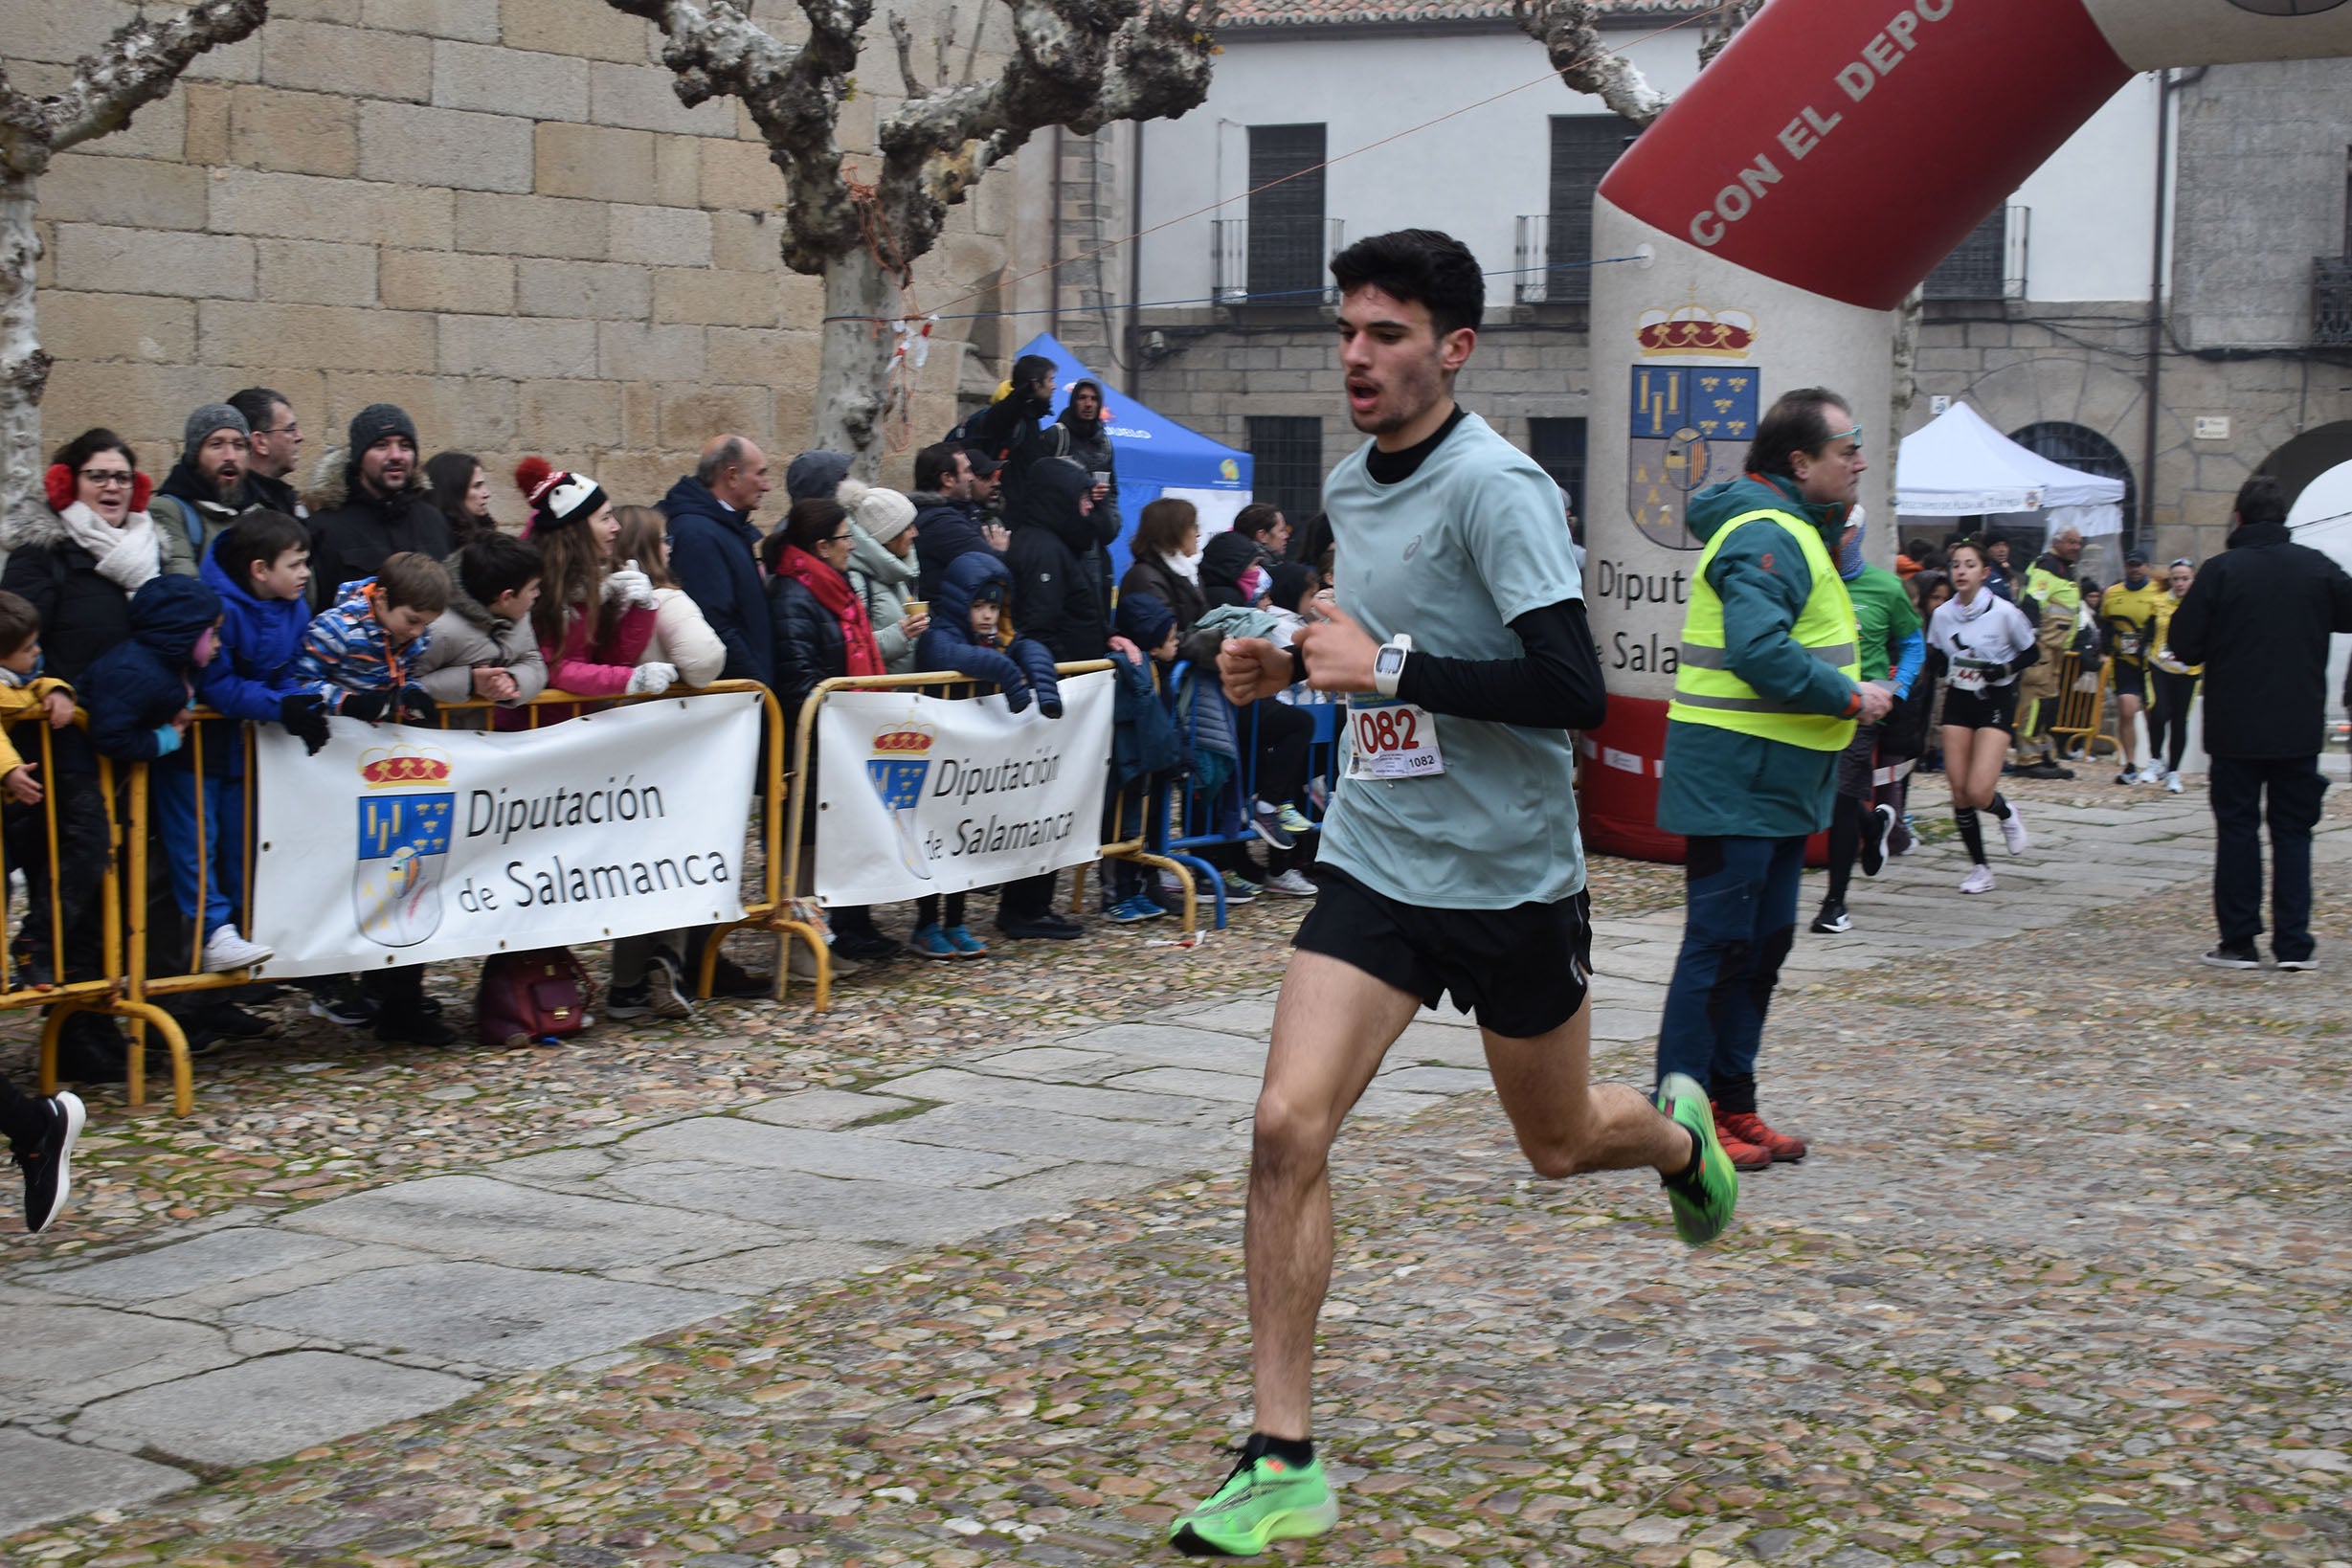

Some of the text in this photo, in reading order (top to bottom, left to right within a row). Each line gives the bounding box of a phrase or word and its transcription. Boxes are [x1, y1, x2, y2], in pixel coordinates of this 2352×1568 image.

[1689, 0, 1954, 246] CON EL DEPO
[1598, 560, 1687, 610] Diput
[1612, 631, 1678, 674] Sala
[1352, 708, 1420, 754] 1082
[931, 746, 1060, 805] Diputación
[1409, 754, 1435, 768] 1082
[466, 774, 666, 844] Diputación
[924, 812, 1073, 860] de Salamanca
[459, 851, 730, 913] de Salamanca
